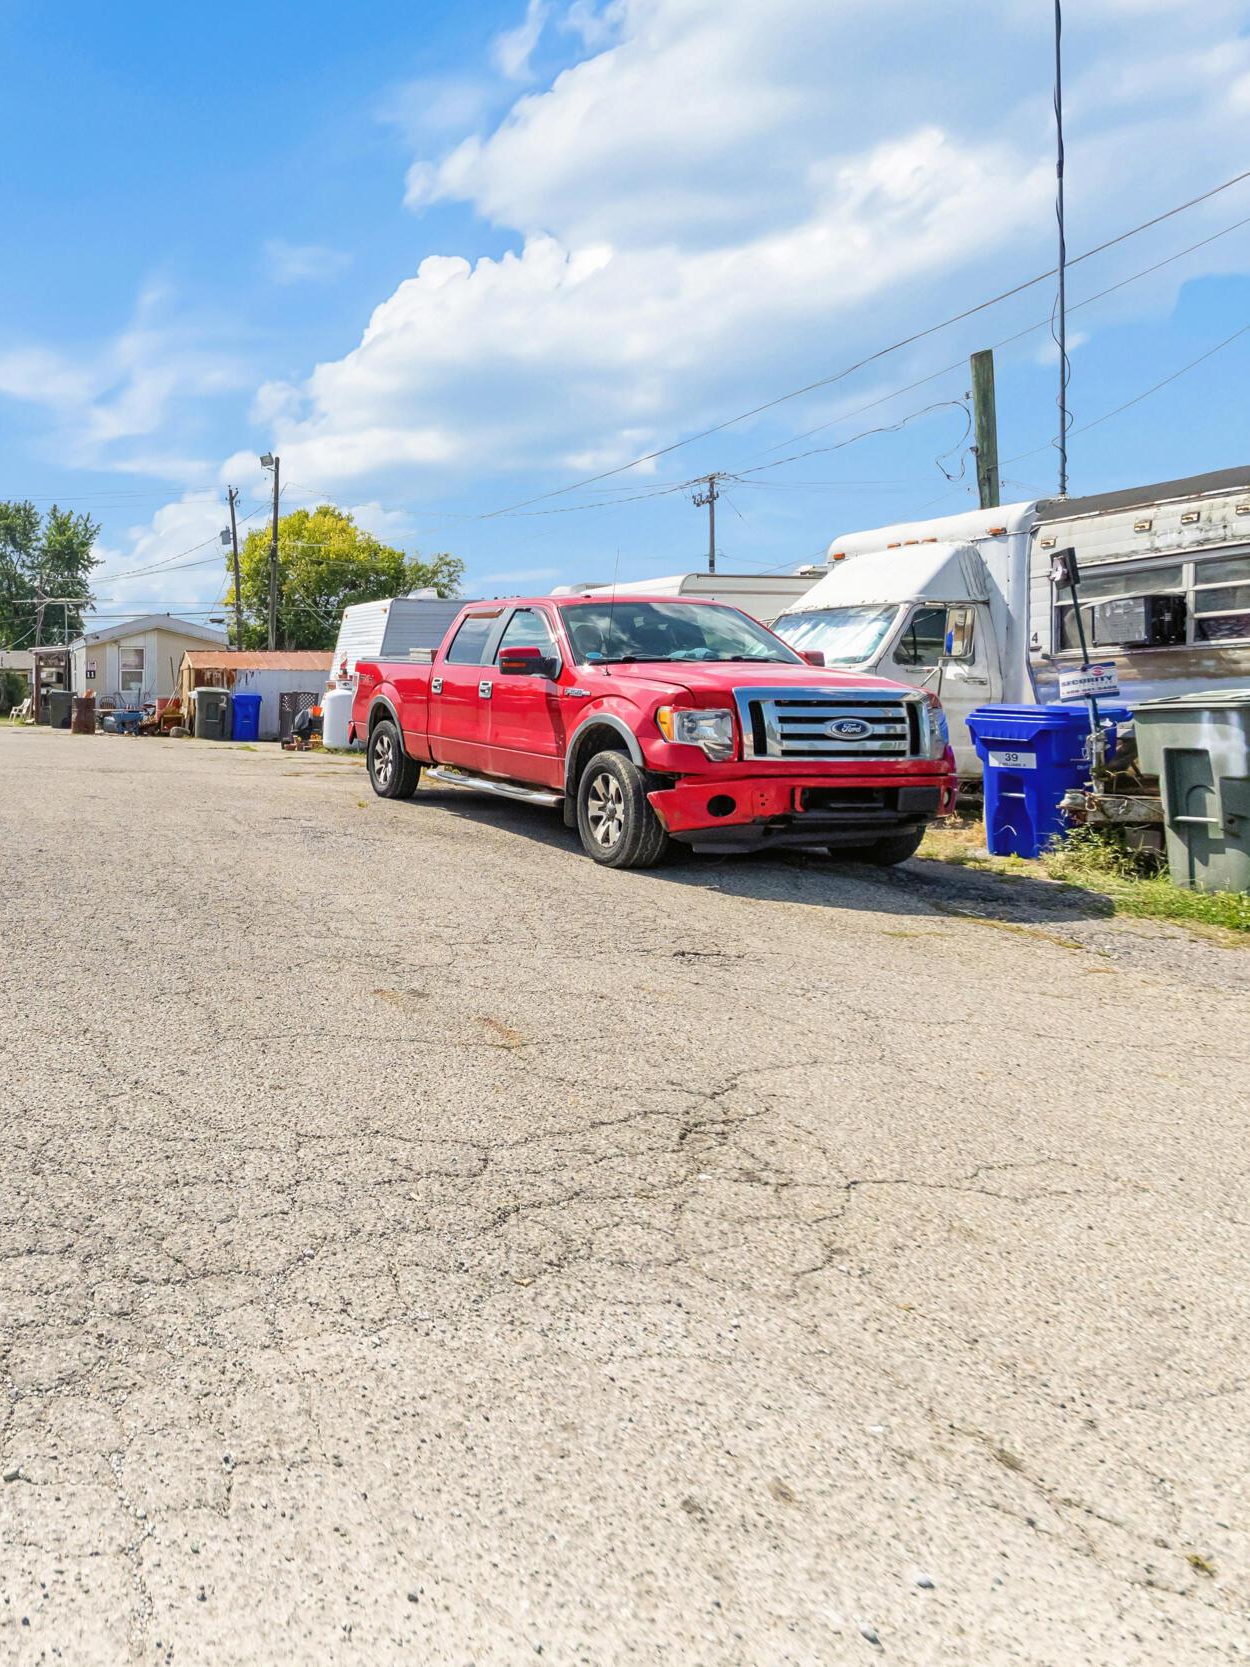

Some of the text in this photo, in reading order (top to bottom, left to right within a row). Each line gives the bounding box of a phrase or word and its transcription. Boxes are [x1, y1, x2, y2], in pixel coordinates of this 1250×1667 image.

[1031, 632, 1038, 644] 4
[1061, 675, 1113, 687] SECURITY
[219, 695, 227, 708] 2
[1005, 753, 1019, 762] 39
